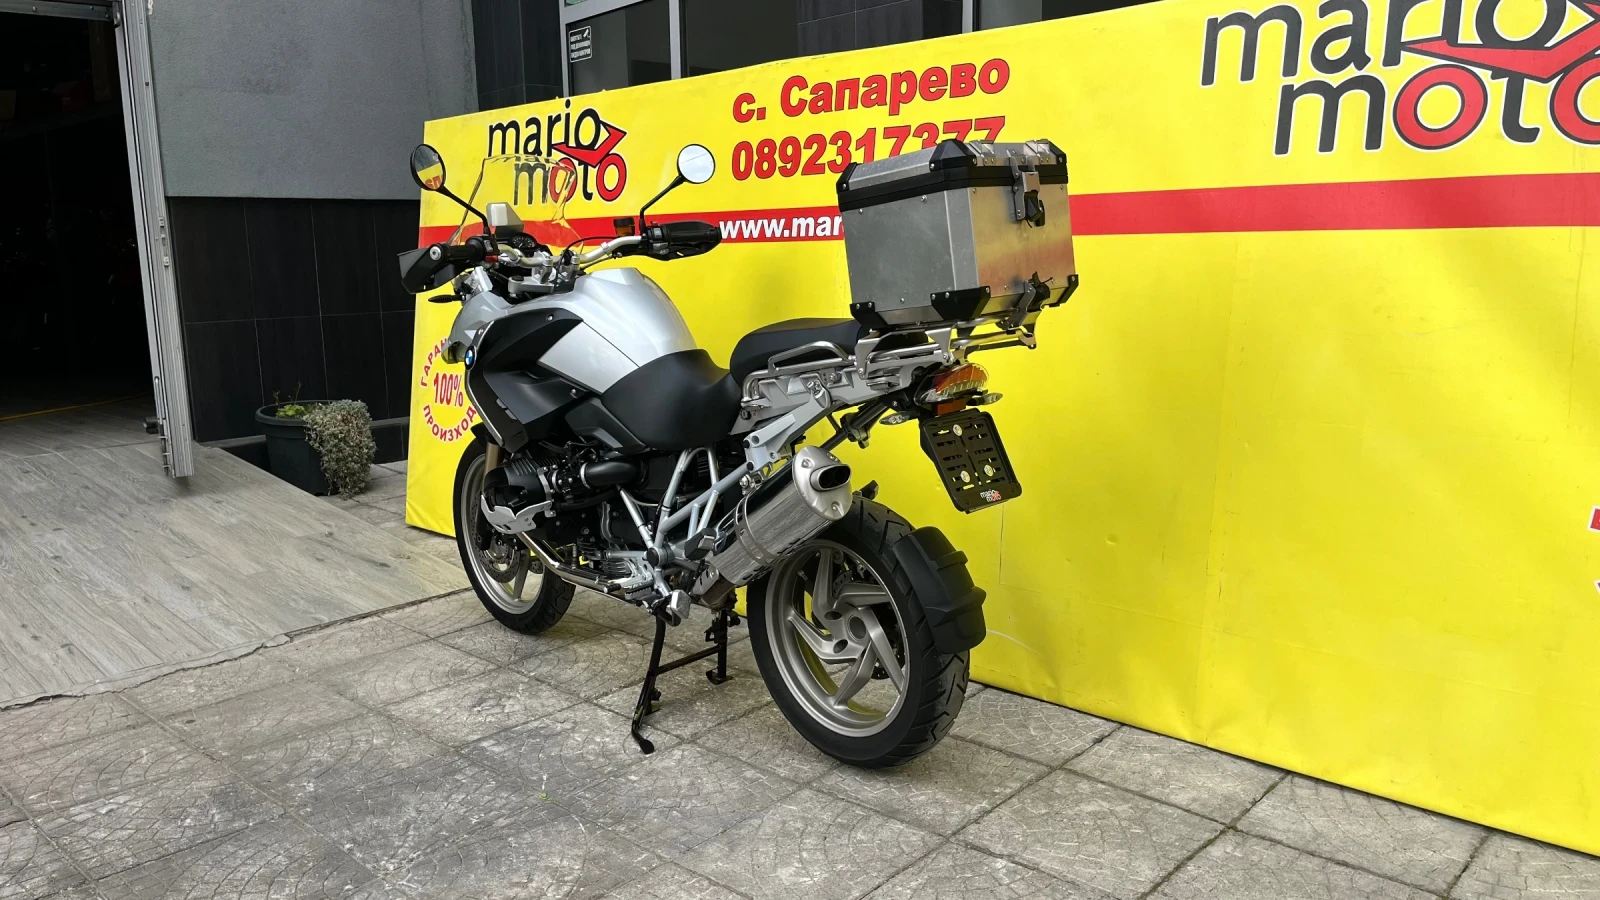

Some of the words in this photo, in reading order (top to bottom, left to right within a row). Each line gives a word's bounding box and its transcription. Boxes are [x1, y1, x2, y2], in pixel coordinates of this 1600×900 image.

[732, 92, 767, 123] с.
[780, 58, 1010, 117] Сапарево
[1273, 57, 1600, 156] moto
[487, 98, 602, 158] mario
[513, 152, 628, 206] moto
[719, 215, 845, 240] www.mar
[433, 371, 464, 408] 100%
[423, 404, 477, 442] ПРОИЗХОД
